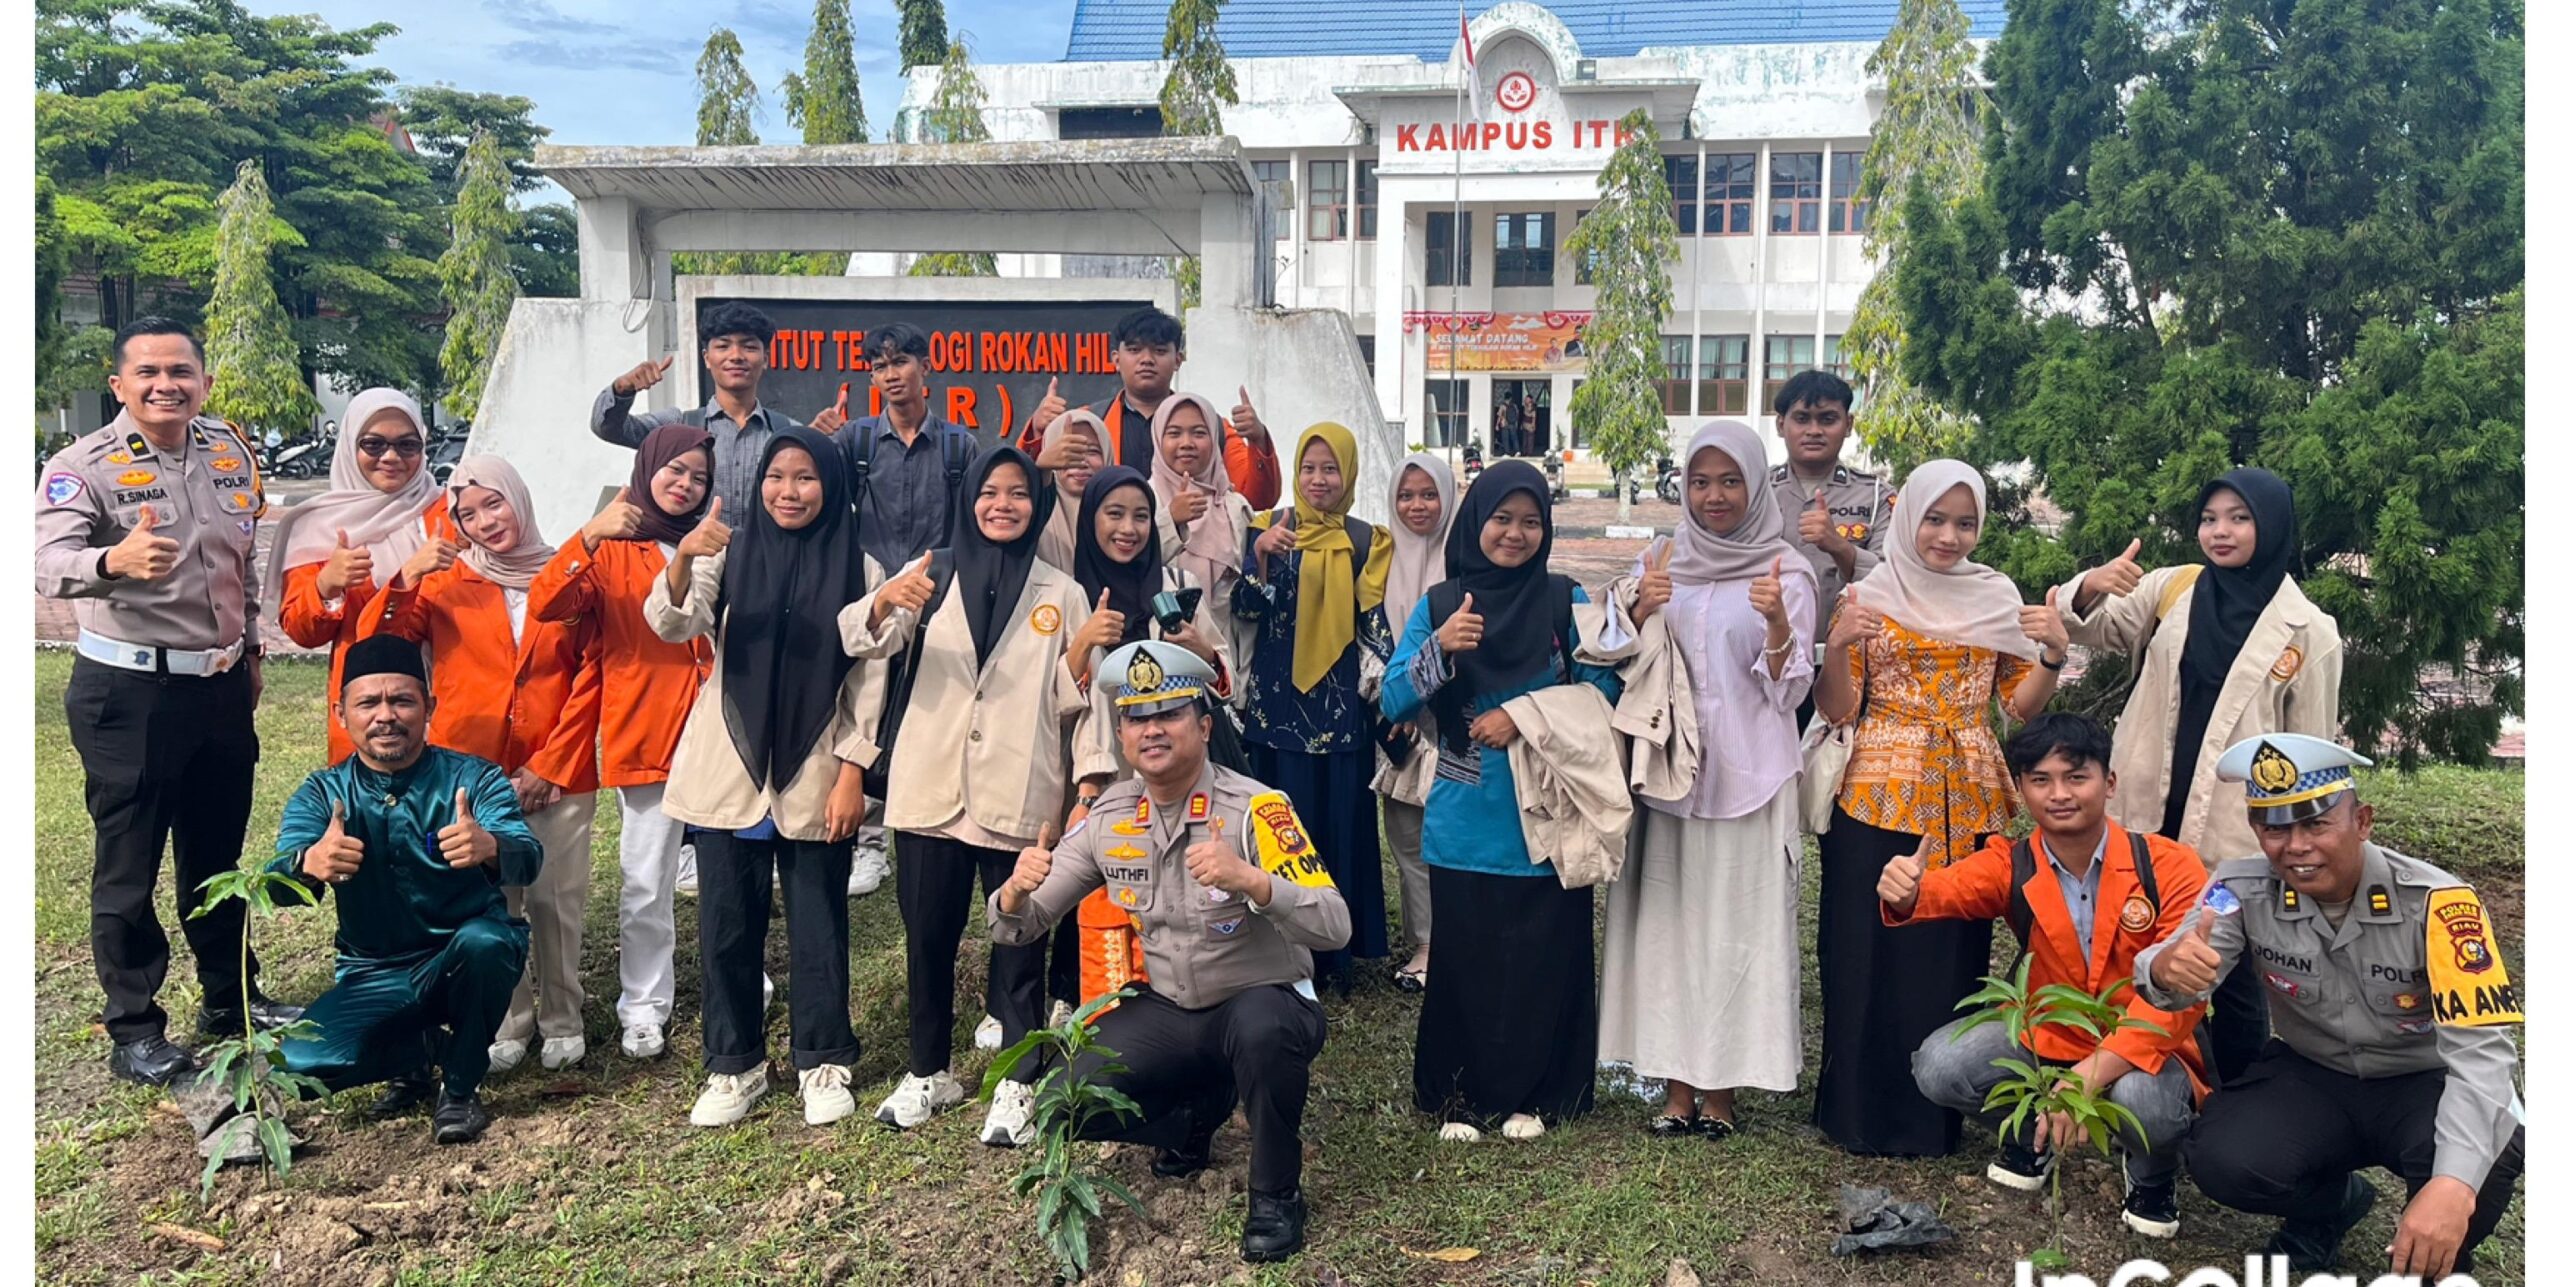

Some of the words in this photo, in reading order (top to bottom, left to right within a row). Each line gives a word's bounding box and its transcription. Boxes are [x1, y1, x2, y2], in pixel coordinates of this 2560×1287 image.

[1397, 121, 1552, 151] KAMPUS
[1487, 333, 1529, 344] DATANG
[980, 331, 1068, 374] ROKAN
[1075, 332, 1120, 374] HIL
[213, 476, 248, 490] POLRI
[117, 487, 168, 505] R.SINAGA
[1829, 506, 1871, 517] POLRI
[1105, 866, 1149, 881] LUTHFI
[2254, 944, 2313, 973] JOHAN
[2433, 989, 2468, 1022] KA
